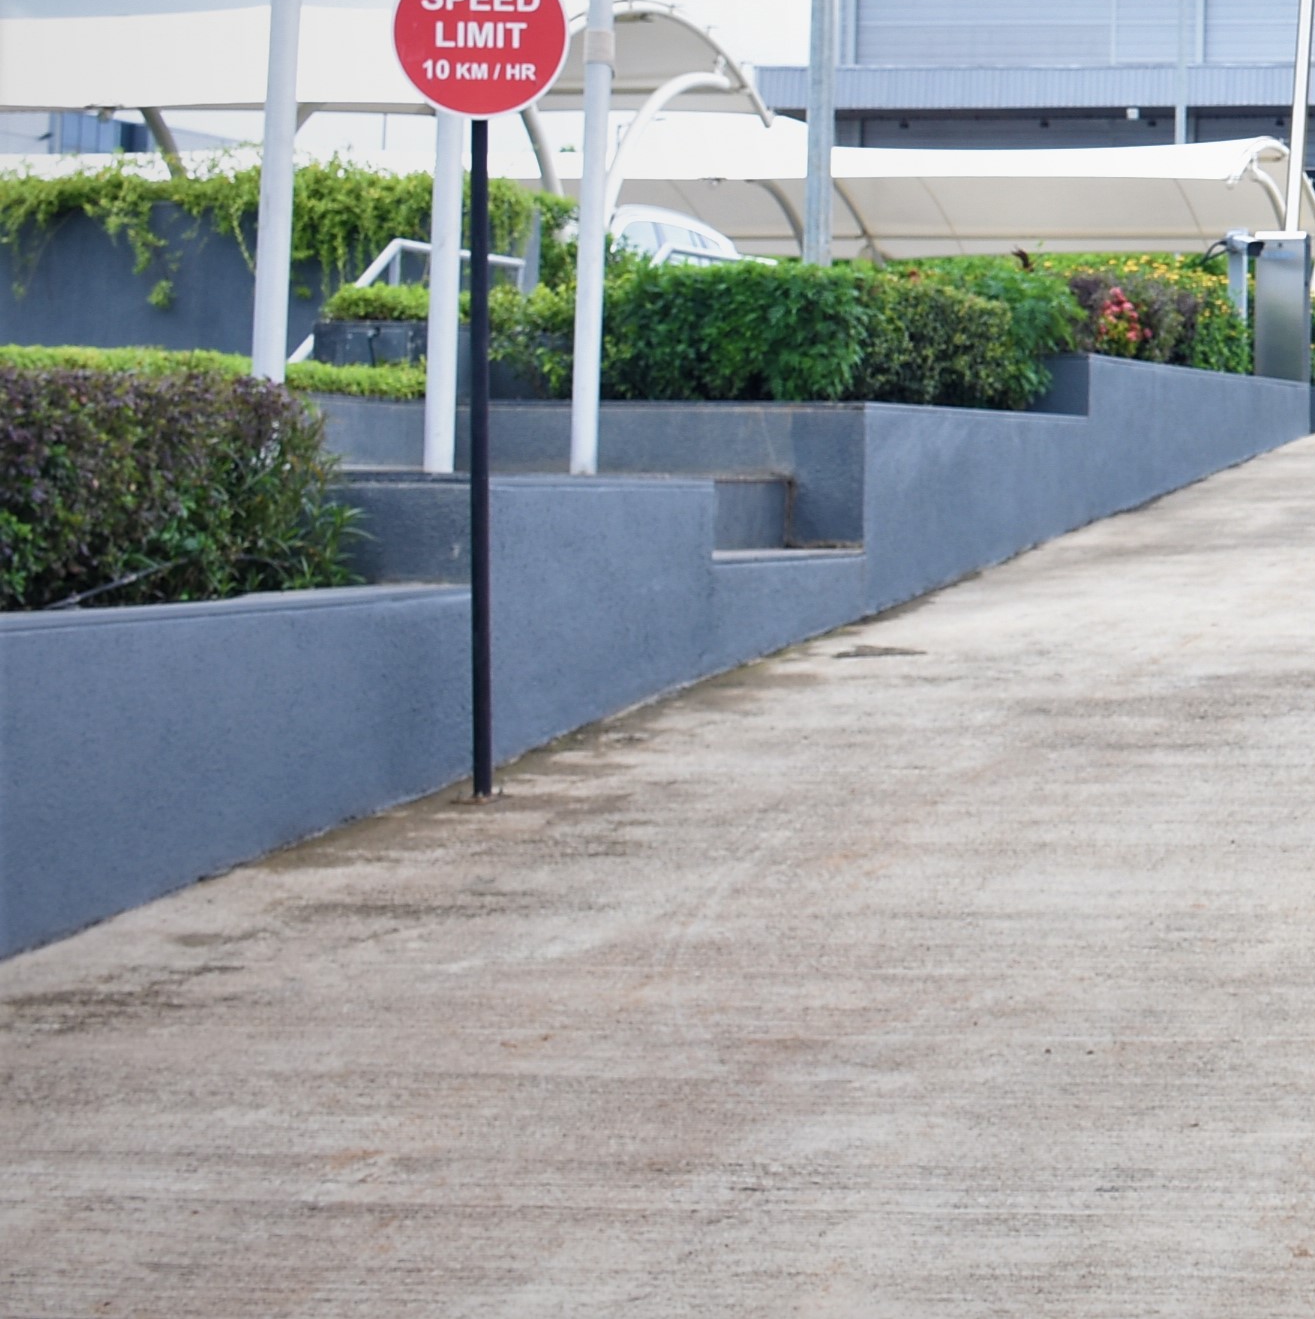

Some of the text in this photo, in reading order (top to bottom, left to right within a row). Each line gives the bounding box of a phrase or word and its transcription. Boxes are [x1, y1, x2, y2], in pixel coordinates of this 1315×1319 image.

[434, 20, 528, 49] LIMIT
[422, 58, 536, 80] 10 KM / HR
